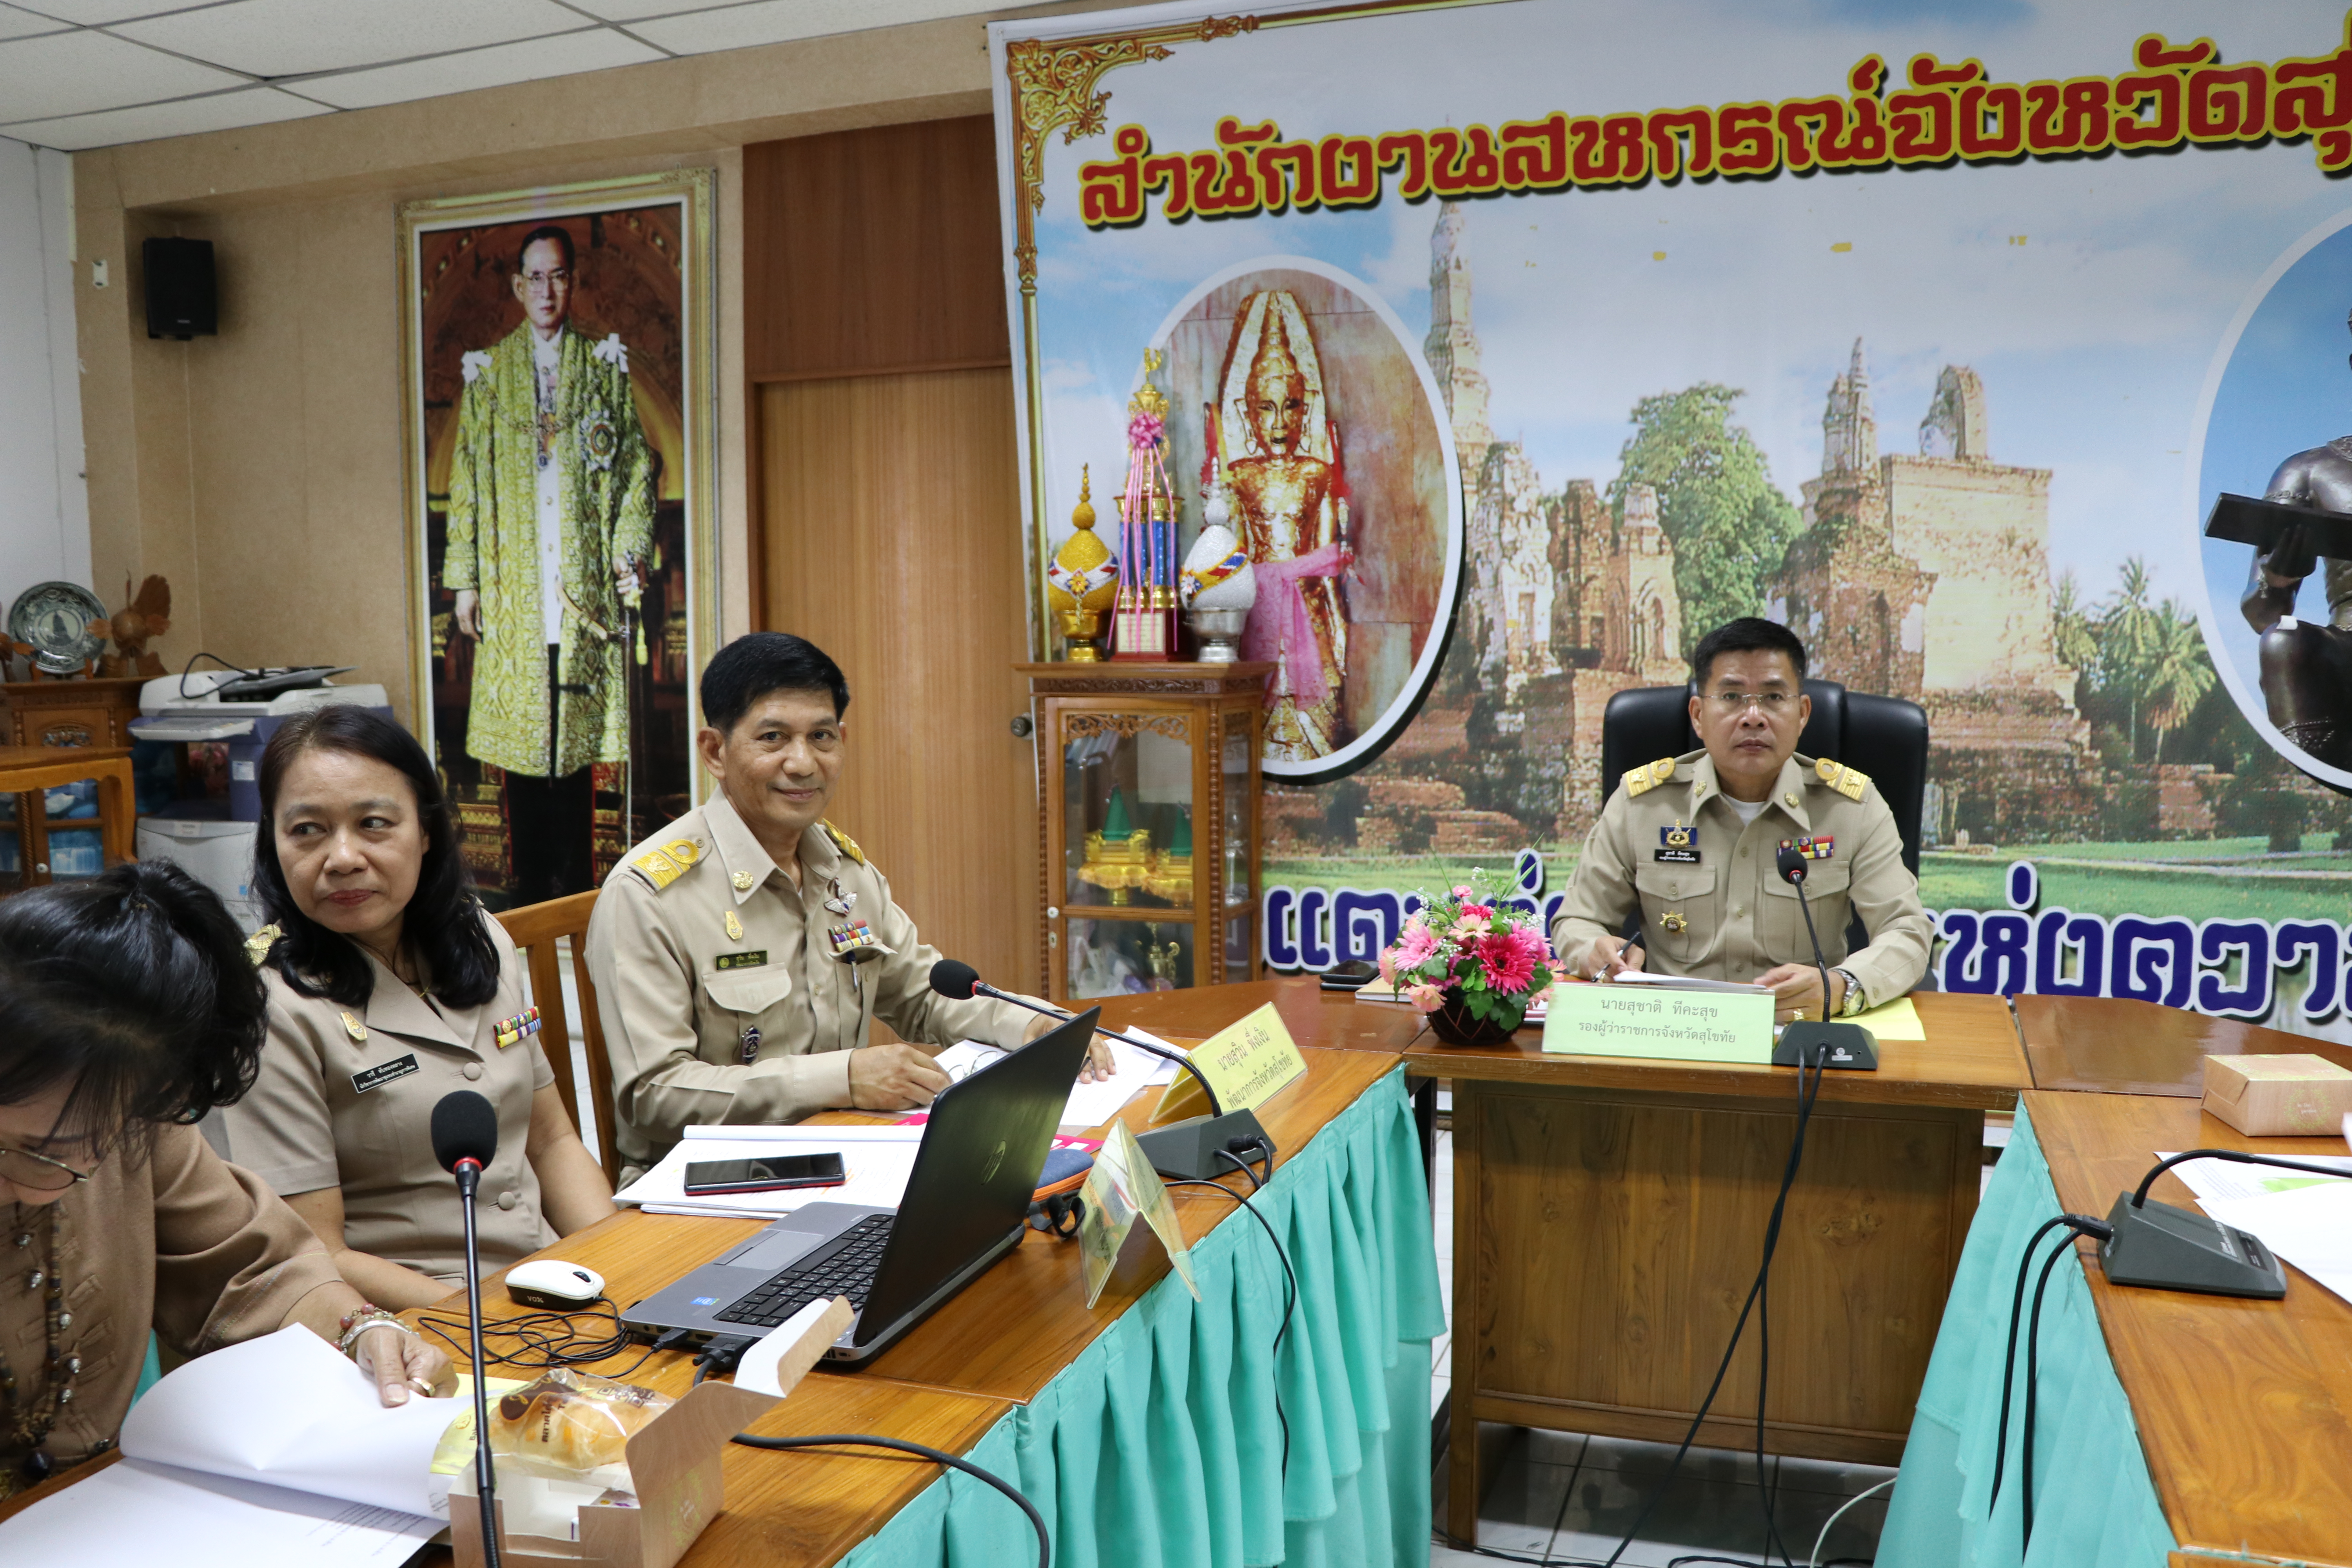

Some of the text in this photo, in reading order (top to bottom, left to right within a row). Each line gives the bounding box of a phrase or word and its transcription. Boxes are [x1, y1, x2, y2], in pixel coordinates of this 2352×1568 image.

[1079, 9, 2352, 225] สำนักงานสหกรณ์จังหวัดสุ
[1601, 998, 1718, 1022] นายสุชาติ ทีคะสุข
[1579, 1020, 1735, 1045] รองผู้ว่าราชการจังหวัดสุโขทัย
[1218, 1042, 1248, 1071] นายสุวิน
[1226, 1050, 1293, 1109] พัฒนาการจังหวัดสุโขทัย
